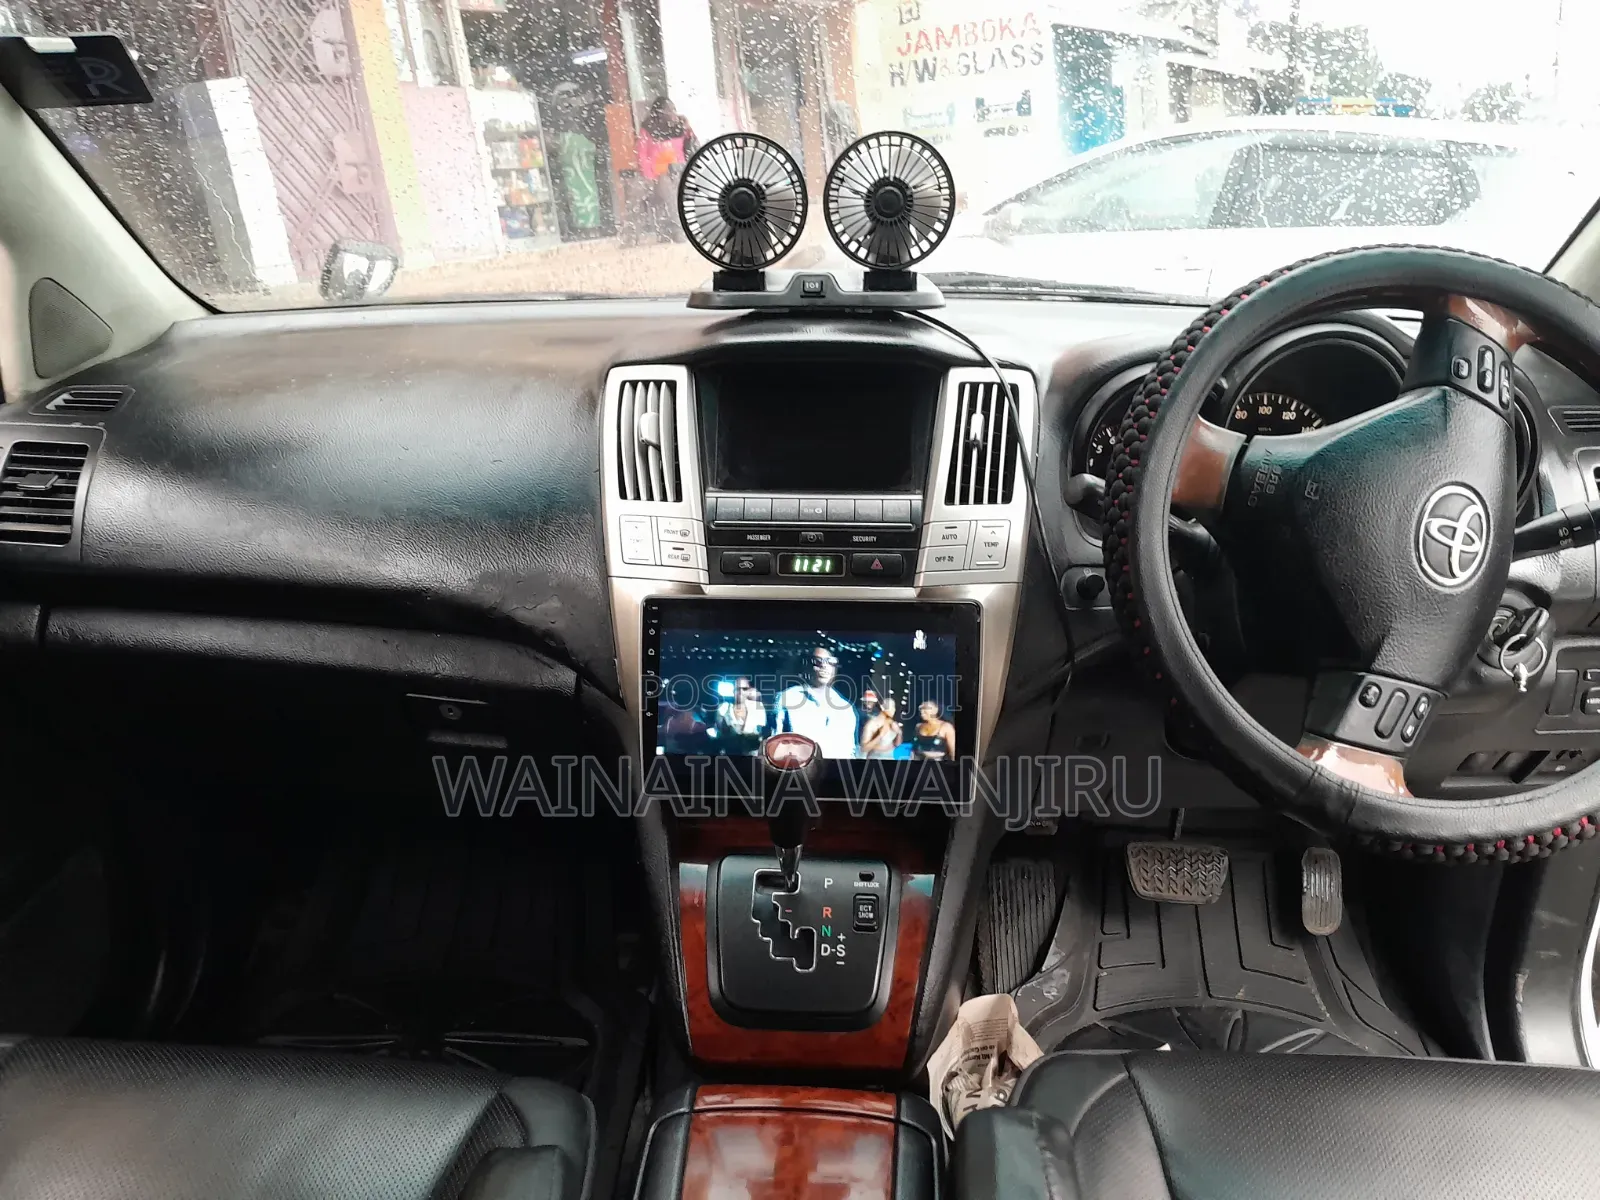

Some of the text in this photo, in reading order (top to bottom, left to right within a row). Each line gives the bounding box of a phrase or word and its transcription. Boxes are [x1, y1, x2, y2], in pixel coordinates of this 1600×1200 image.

[1235, 410, 1248, 420] 80
[1258, 406, 1272, 415] 100
[1282, 411, 1296, 420] 120
[1109, 435, 1116, 445] 6
[1095, 444, 1103, 454] 5
[746, 533, 771, 541] PASSENGER
[852, 534, 877, 543] SECURITY
[941, 533, 958, 541] AUTO
[934, 555, 946, 563] OFF
[823, 877, 834, 889] P
[822, 906, 833, 918] R
[859, 904, 873, 912] ECT
[821, 924, 832, 937] N
